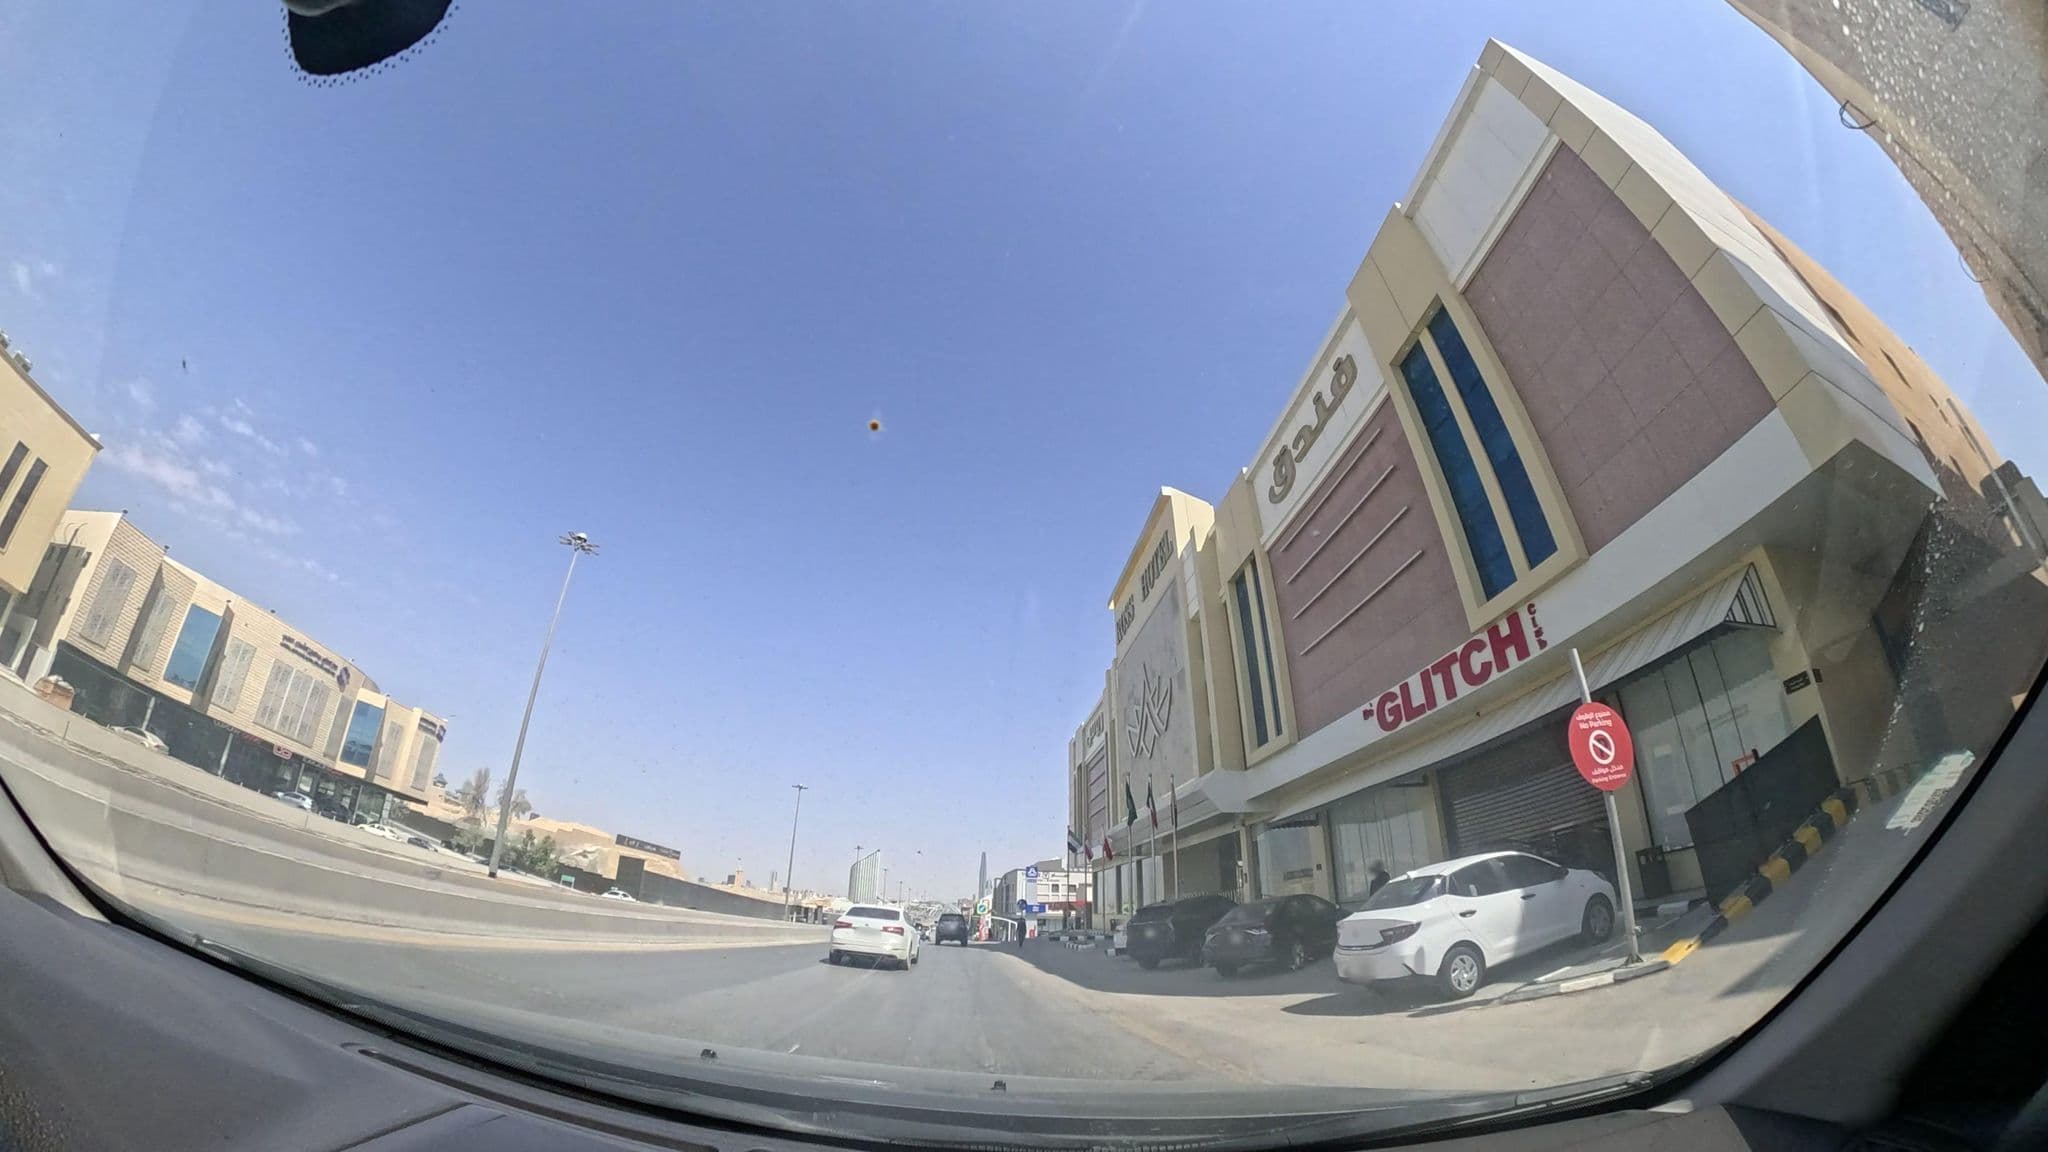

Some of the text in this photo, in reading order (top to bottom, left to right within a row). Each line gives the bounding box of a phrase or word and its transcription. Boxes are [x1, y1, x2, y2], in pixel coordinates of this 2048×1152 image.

[1268, 353, 1358, 505] فندق
[1141, 529, 1174, 602] HOTEL
[1376, 611, 1531, 732] GLITCH
[1579, 718, 1613, 730] No Parking
